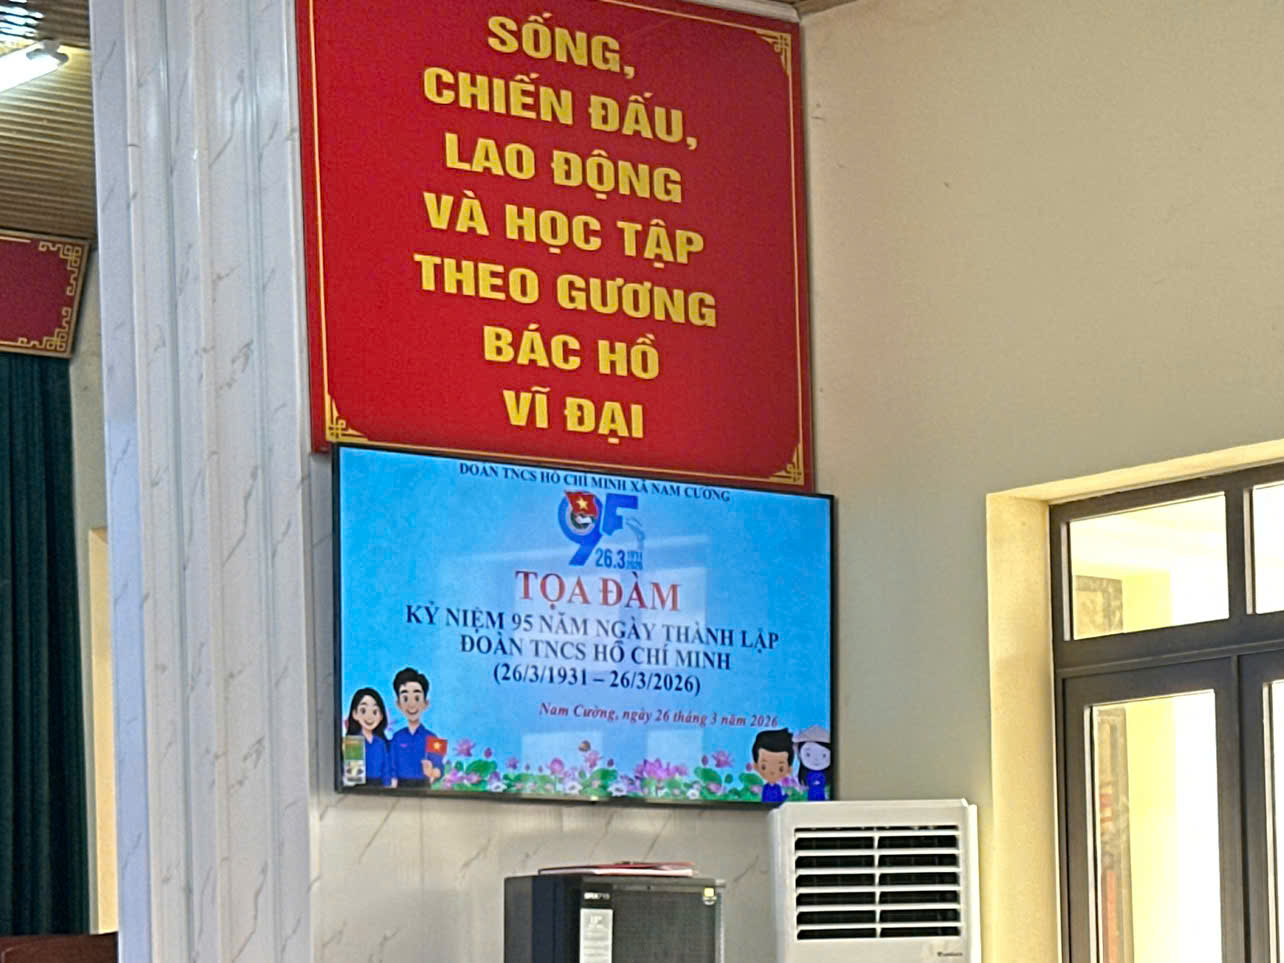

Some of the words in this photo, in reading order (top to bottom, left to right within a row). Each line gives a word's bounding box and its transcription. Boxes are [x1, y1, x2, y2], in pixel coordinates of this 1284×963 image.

[487, 12, 636, 80] SỐNG,
[423, 66, 574, 126] CHIẾN
[588, 92, 698, 150] ĐẤU,
[444, 132, 536, 180] LAO
[551, 149, 683, 203] ĐỘNG
[422, 190, 489, 236] VÀ
[505, 205, 602, 254] HỌC
[617, 219, 705, 268] TẬP
[413, 253, 540, 304] THEO
[556, 273, 717, 328] GƯƠNG
[483, 323, 581, 371] BÁC
[597, 333, 661, 380] HỒ
[503, 386, 551, 430] VĨ
[564, 397, 645, 444] ĐẠI
[502, 467, 538, 481] TNCS
[591, 474, 627, 490] MINH
[651, 480, 681, 497] NAM
[595, 548, 625, 569] 26.3
[515, 570, 591, 611] TỌA
[599, 571, 682, 611] ĐÀM
[446, 607, 505, 634] NIỆM
[512, 613, 533, 632] 95
[539, 612, 589, 636] NĂM
[596, 616, 656, 641] NGÀY
[662, 621, 735, 647] THÀNH
[741, 628, 780, 654] LẬP
[460, 631, 524, 656] ĐOÀN
[529, 639, 587, 661] TNCS
[593, 640, 625, 664] HỒ
[631, 643, 669, 666] CHÍ
[675, 650, 732, 670] MINH
[493, 663, 587, 685] (26/3/1931
[609, 669, 701, 697] 26/3/2026)
[538, 702, 569, 717] Nam
[655, 708, 670, 723] 26
[710, 711, 718, 725] 3
[750, 714, 779, 728] 2026
